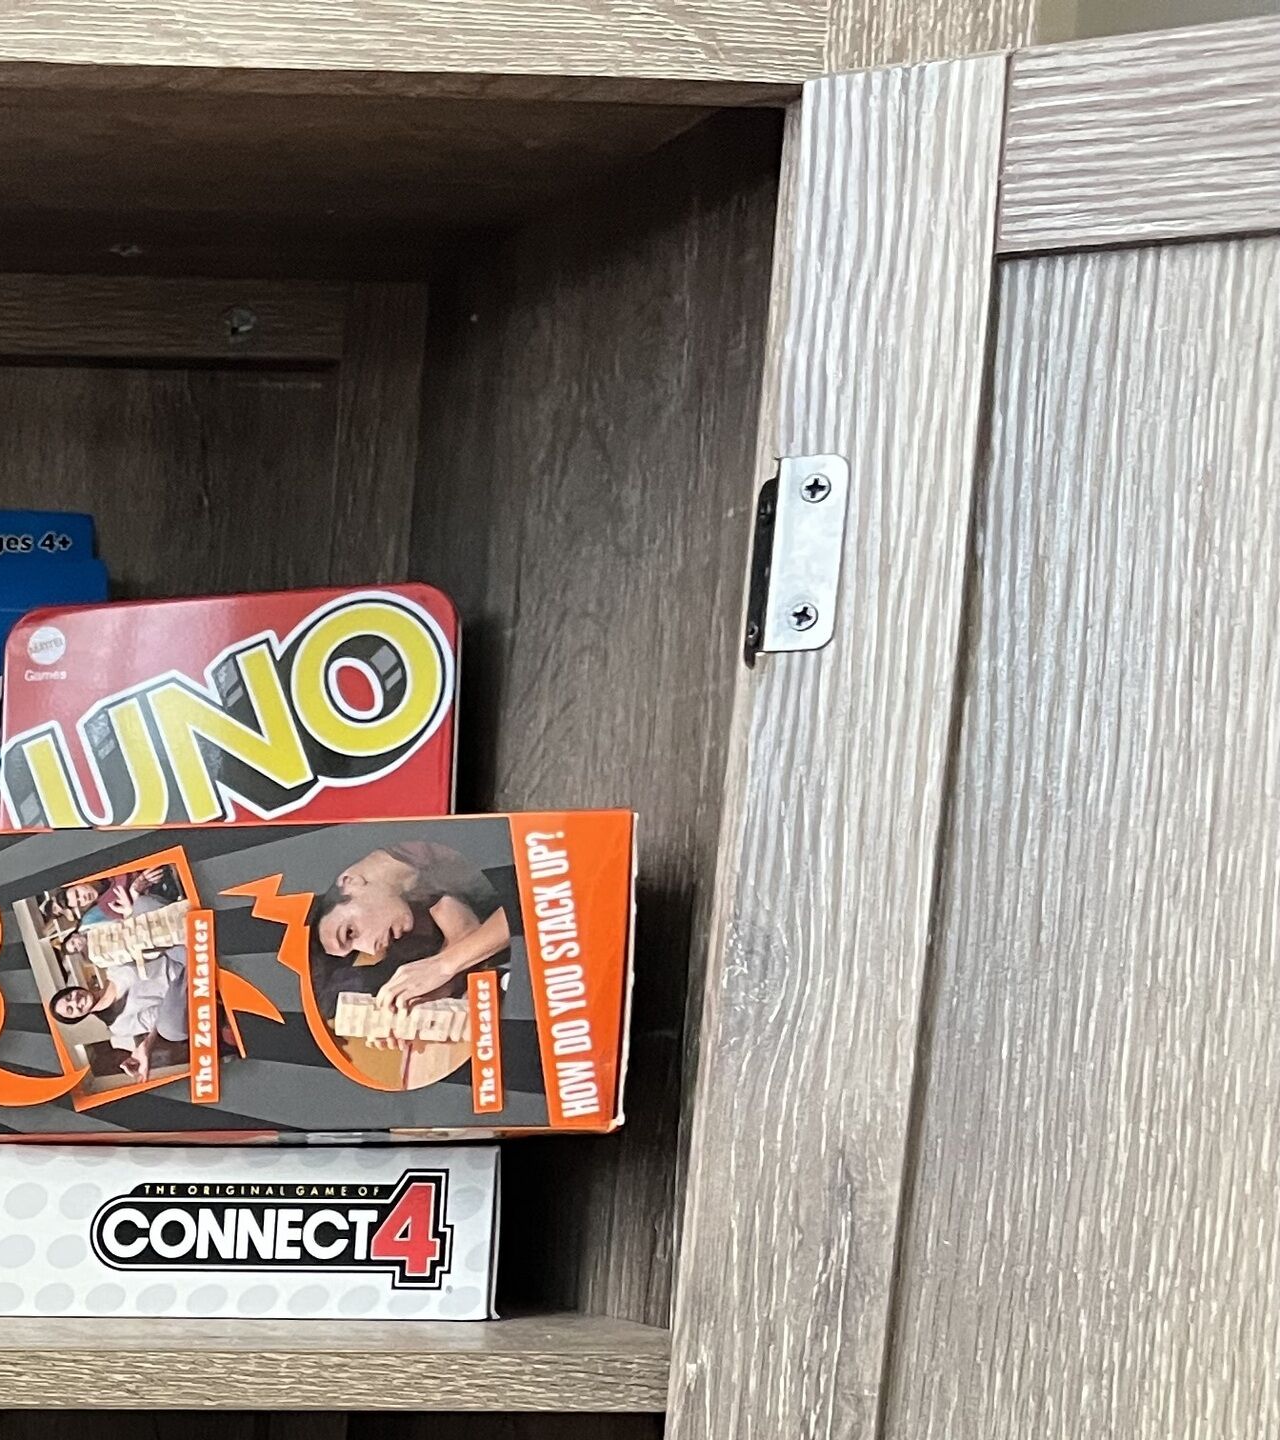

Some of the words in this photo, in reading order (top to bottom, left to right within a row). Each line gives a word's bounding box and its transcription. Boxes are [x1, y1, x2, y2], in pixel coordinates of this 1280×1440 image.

[40, 532, 72, 553] 4+
[24, 669, 67, 682] Games
[8, 597, 448, 828] UNO
[525, 828, 570, 877] UP?
[531, 882, 582, 957] STACK
[190, 918, 210, 1005] Master
[544, 961, 585, 1015] YOU
[194, 1010, 211, 1050] Zen
[474, 979, 494, 1062] Cheater
[551, 1020, 590, 1062] DO
[195, 1056, 214, 1098] The
[479, 1066, 496, 1107] The
[561, 1066, 600, 1117] HOW
[143, 1184, 179, 1197] THE
[187, 1184, 290, 1197] ORIGINAL
[294, 1184, 353, 1198] GAME
[361, 1185, 381, 1198] OF
[101, 1208, 379, 1261] CONNECT
[372, 1178, 441, 1276] 4
